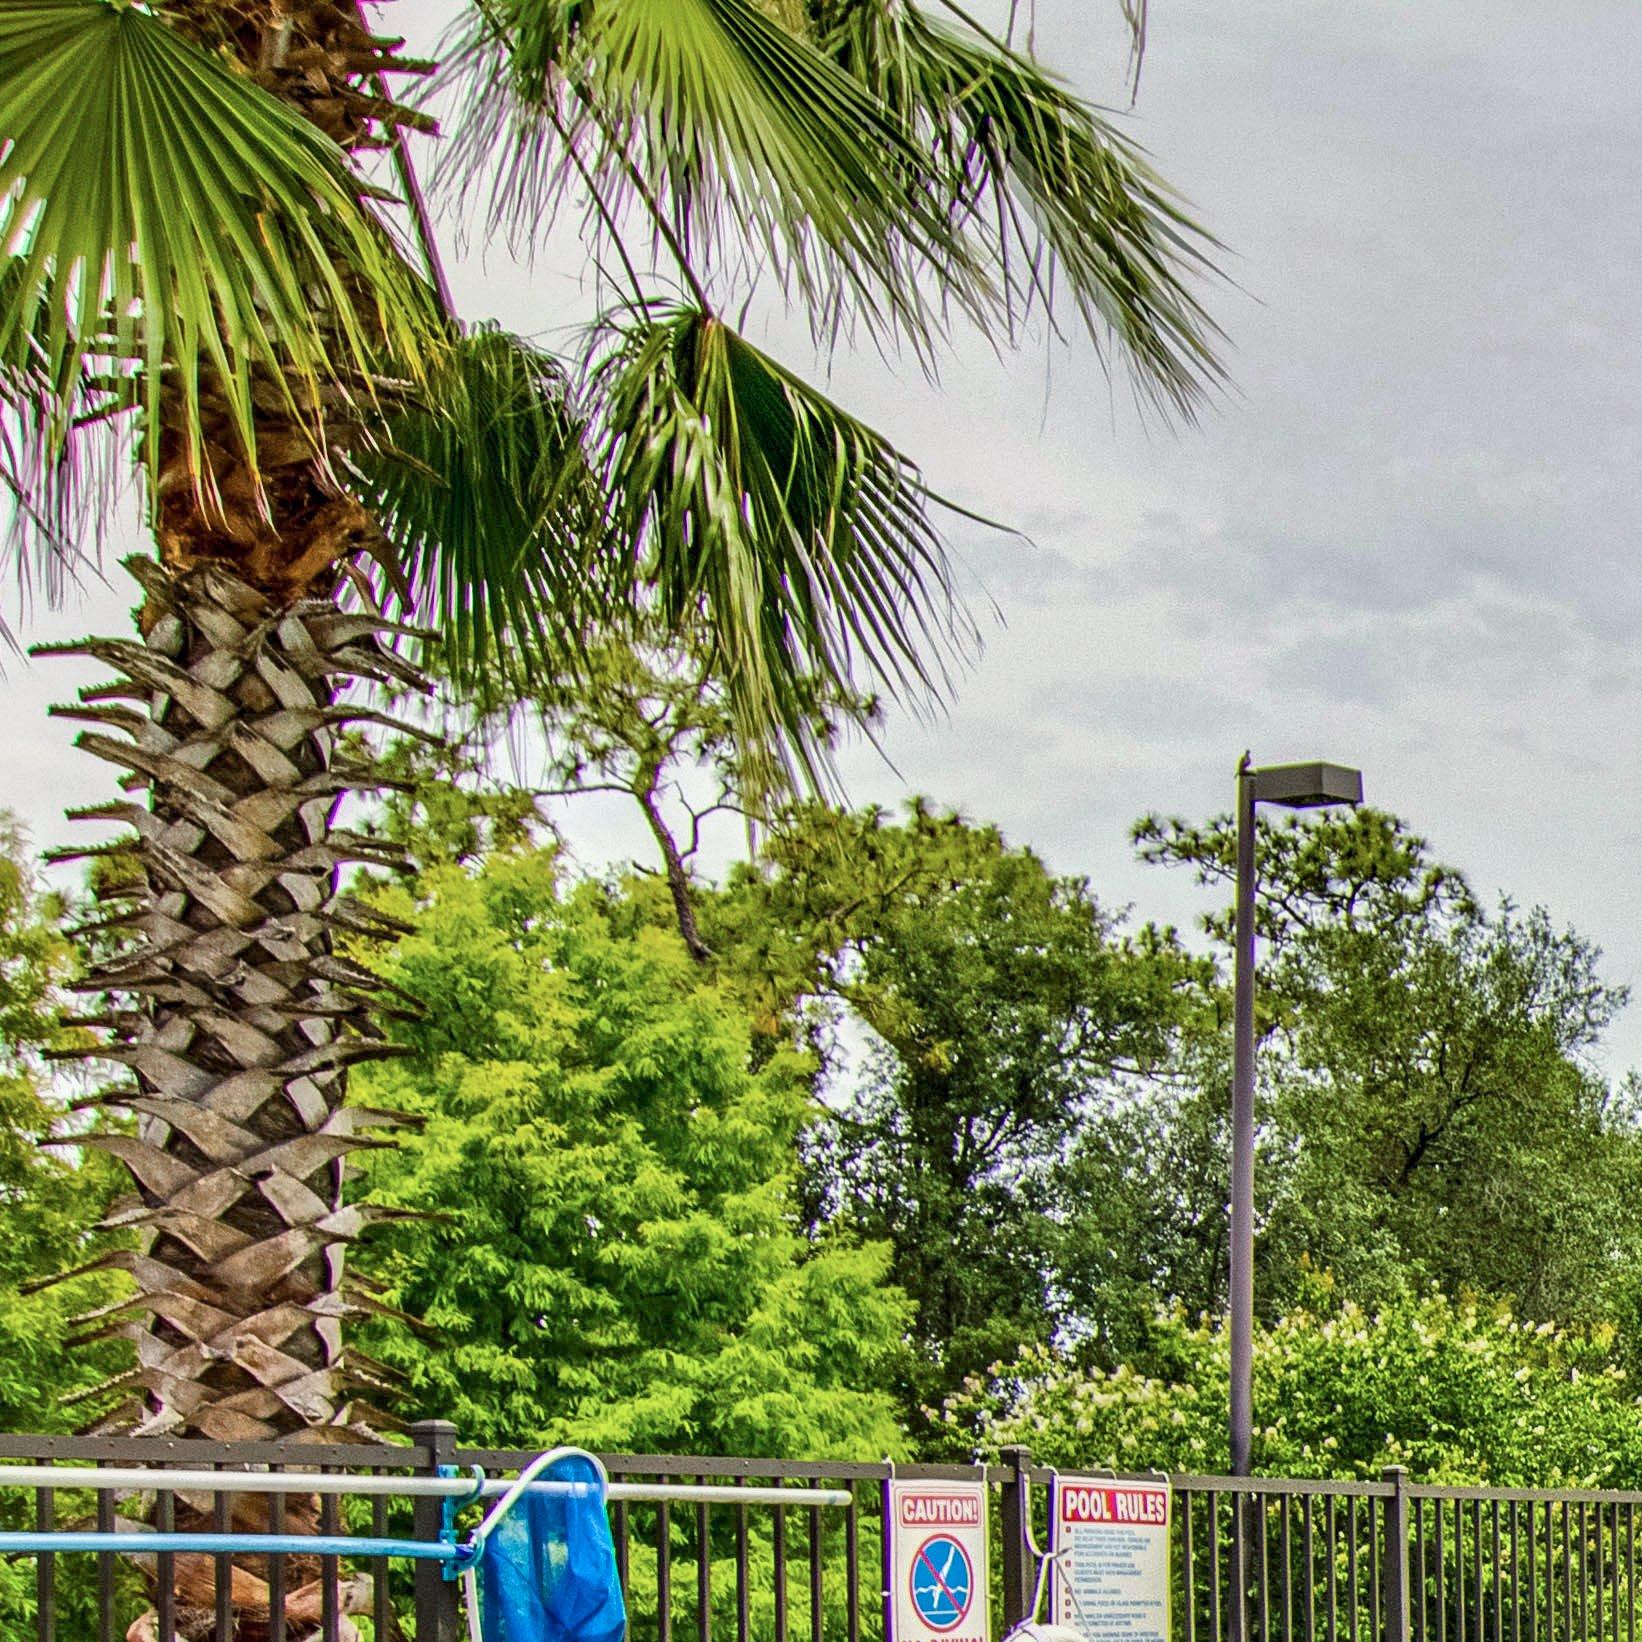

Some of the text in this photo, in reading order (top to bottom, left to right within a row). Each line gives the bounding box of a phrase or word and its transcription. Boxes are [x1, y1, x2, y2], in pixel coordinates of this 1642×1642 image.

[902, 1496, 978, 1521] CAUTION!
[1066, 1489, 1164, 1523] POOL RULES
